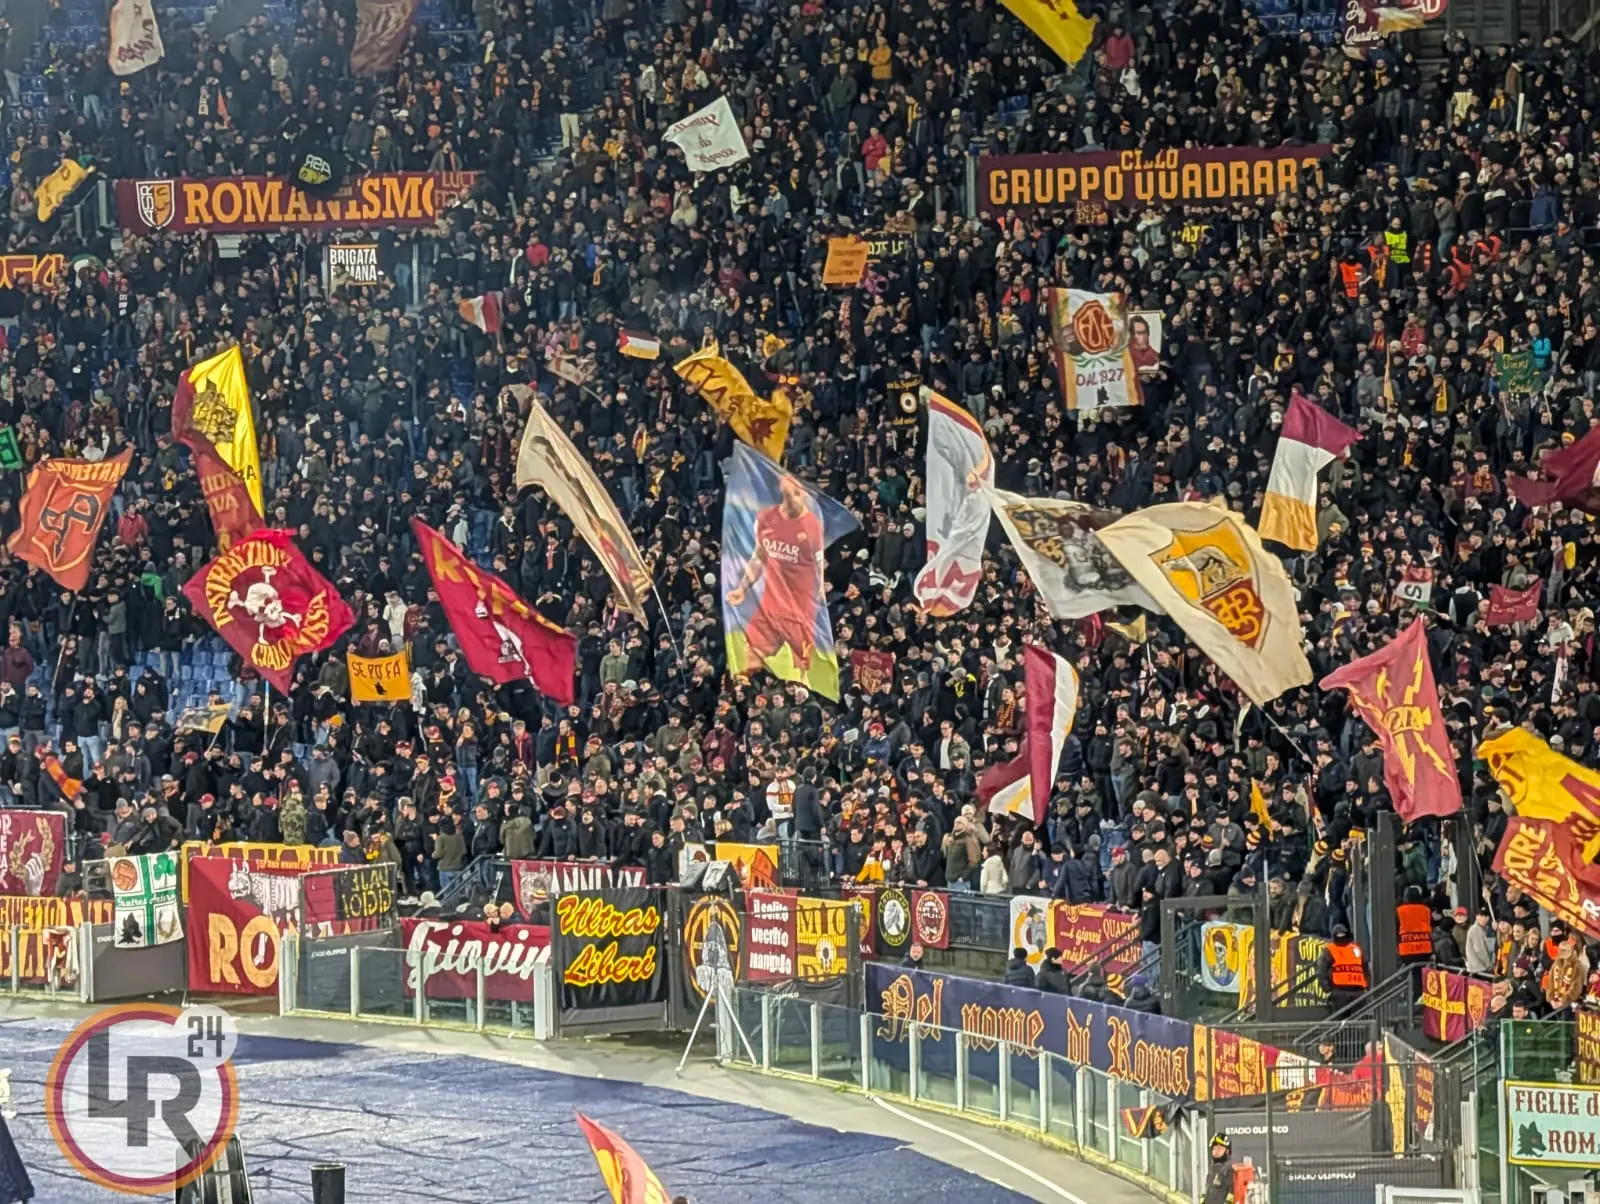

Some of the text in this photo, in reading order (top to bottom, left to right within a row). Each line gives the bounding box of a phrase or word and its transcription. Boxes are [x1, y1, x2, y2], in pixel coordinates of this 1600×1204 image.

[990, 165, 1124, 206] GRUPPO
[330, 248, 377, 265] BRIGATA
[762, 538, 800, 556] QATAR
[351, 661, 367, 678] SE
[367, 663, 383, 680] PO
[557, 894, 661, 938] Ultras
[564, 941, 656, 987] Liberi
[961, 1001, 1046, 1060] nome
[1067, 1006, 1093, 1067] di
[1107, 1014, 1190, 1096] Roma
[1515, 1089, 1580, 1116] FIGLIE
[1225, 1126, 1252, 1135] STADIO
